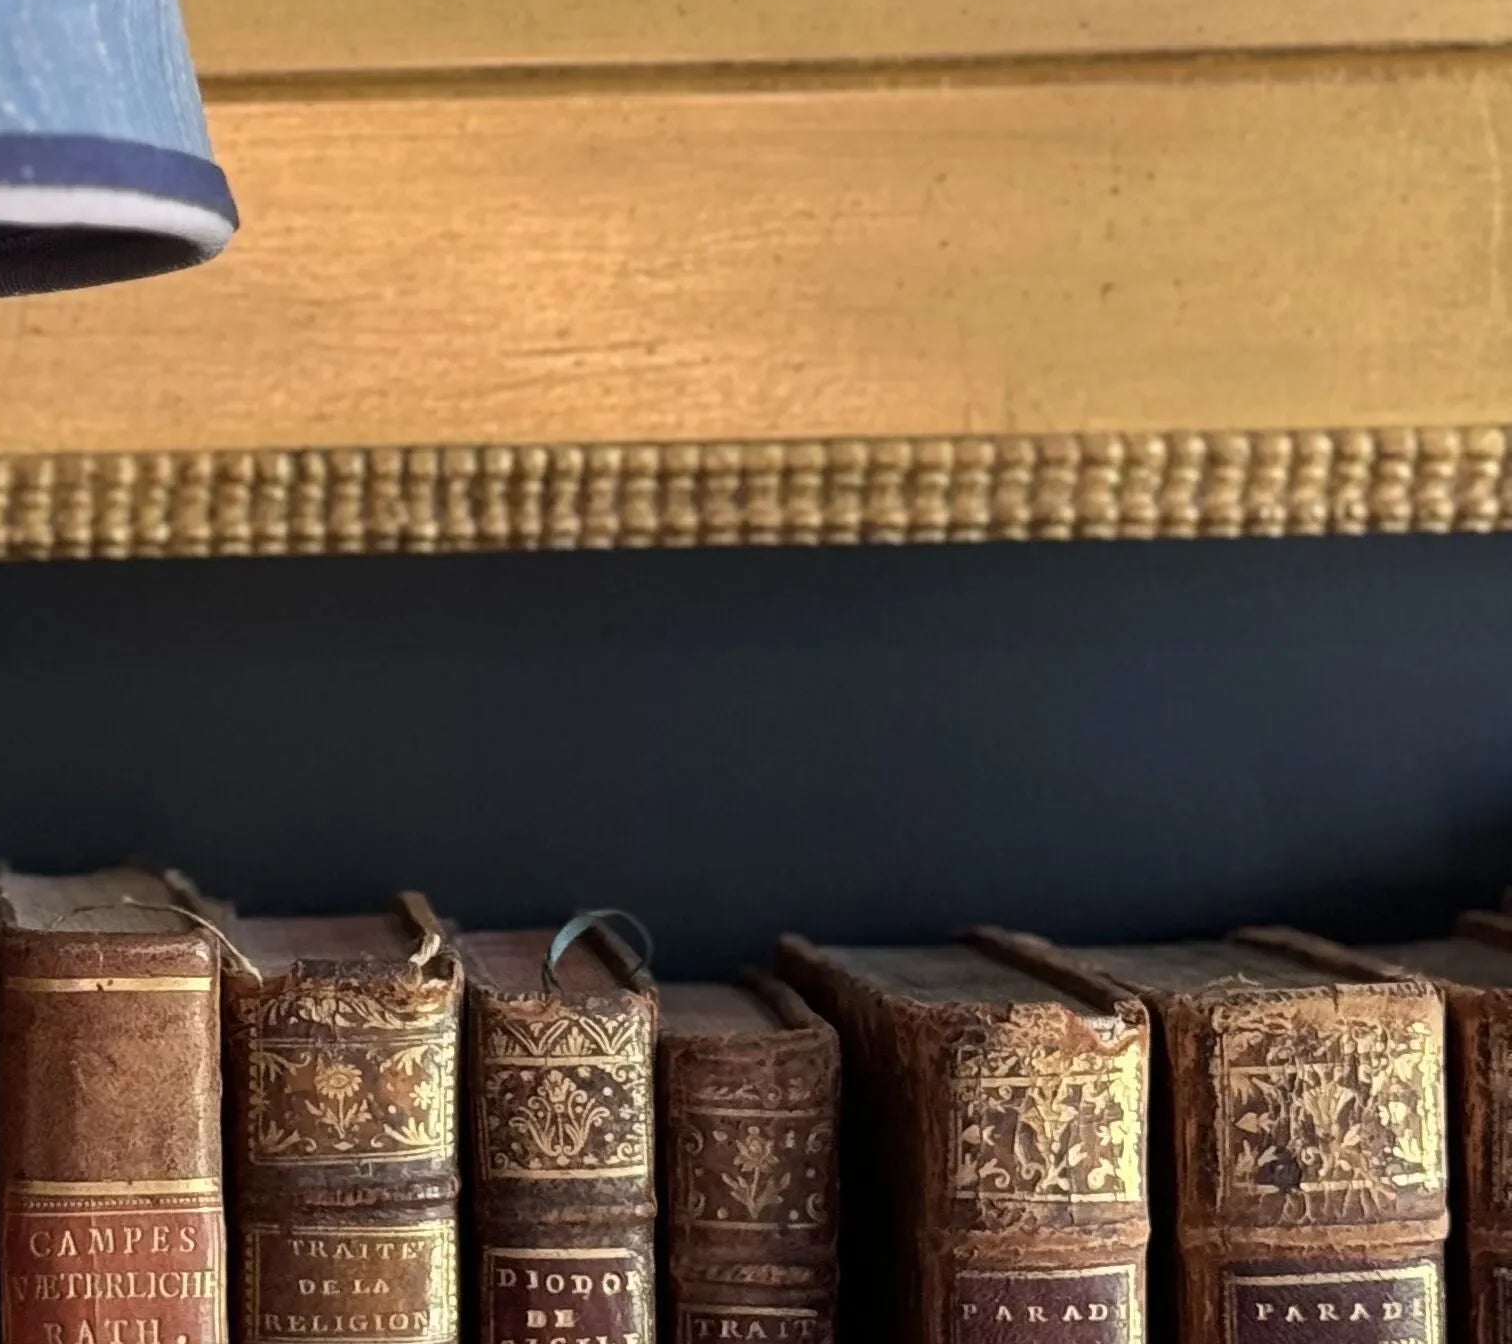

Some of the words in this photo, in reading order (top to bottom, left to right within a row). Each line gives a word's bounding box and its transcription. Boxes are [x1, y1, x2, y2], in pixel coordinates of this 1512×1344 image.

[29, 1224, 198, 1258] CAMPES
[298, 1278, 341, 1296] DE
[351, 1277, 391, 1295] LA
[264, 1311, 430, 1335] RELIGION
[526, 1308, 577, 1329] DE
